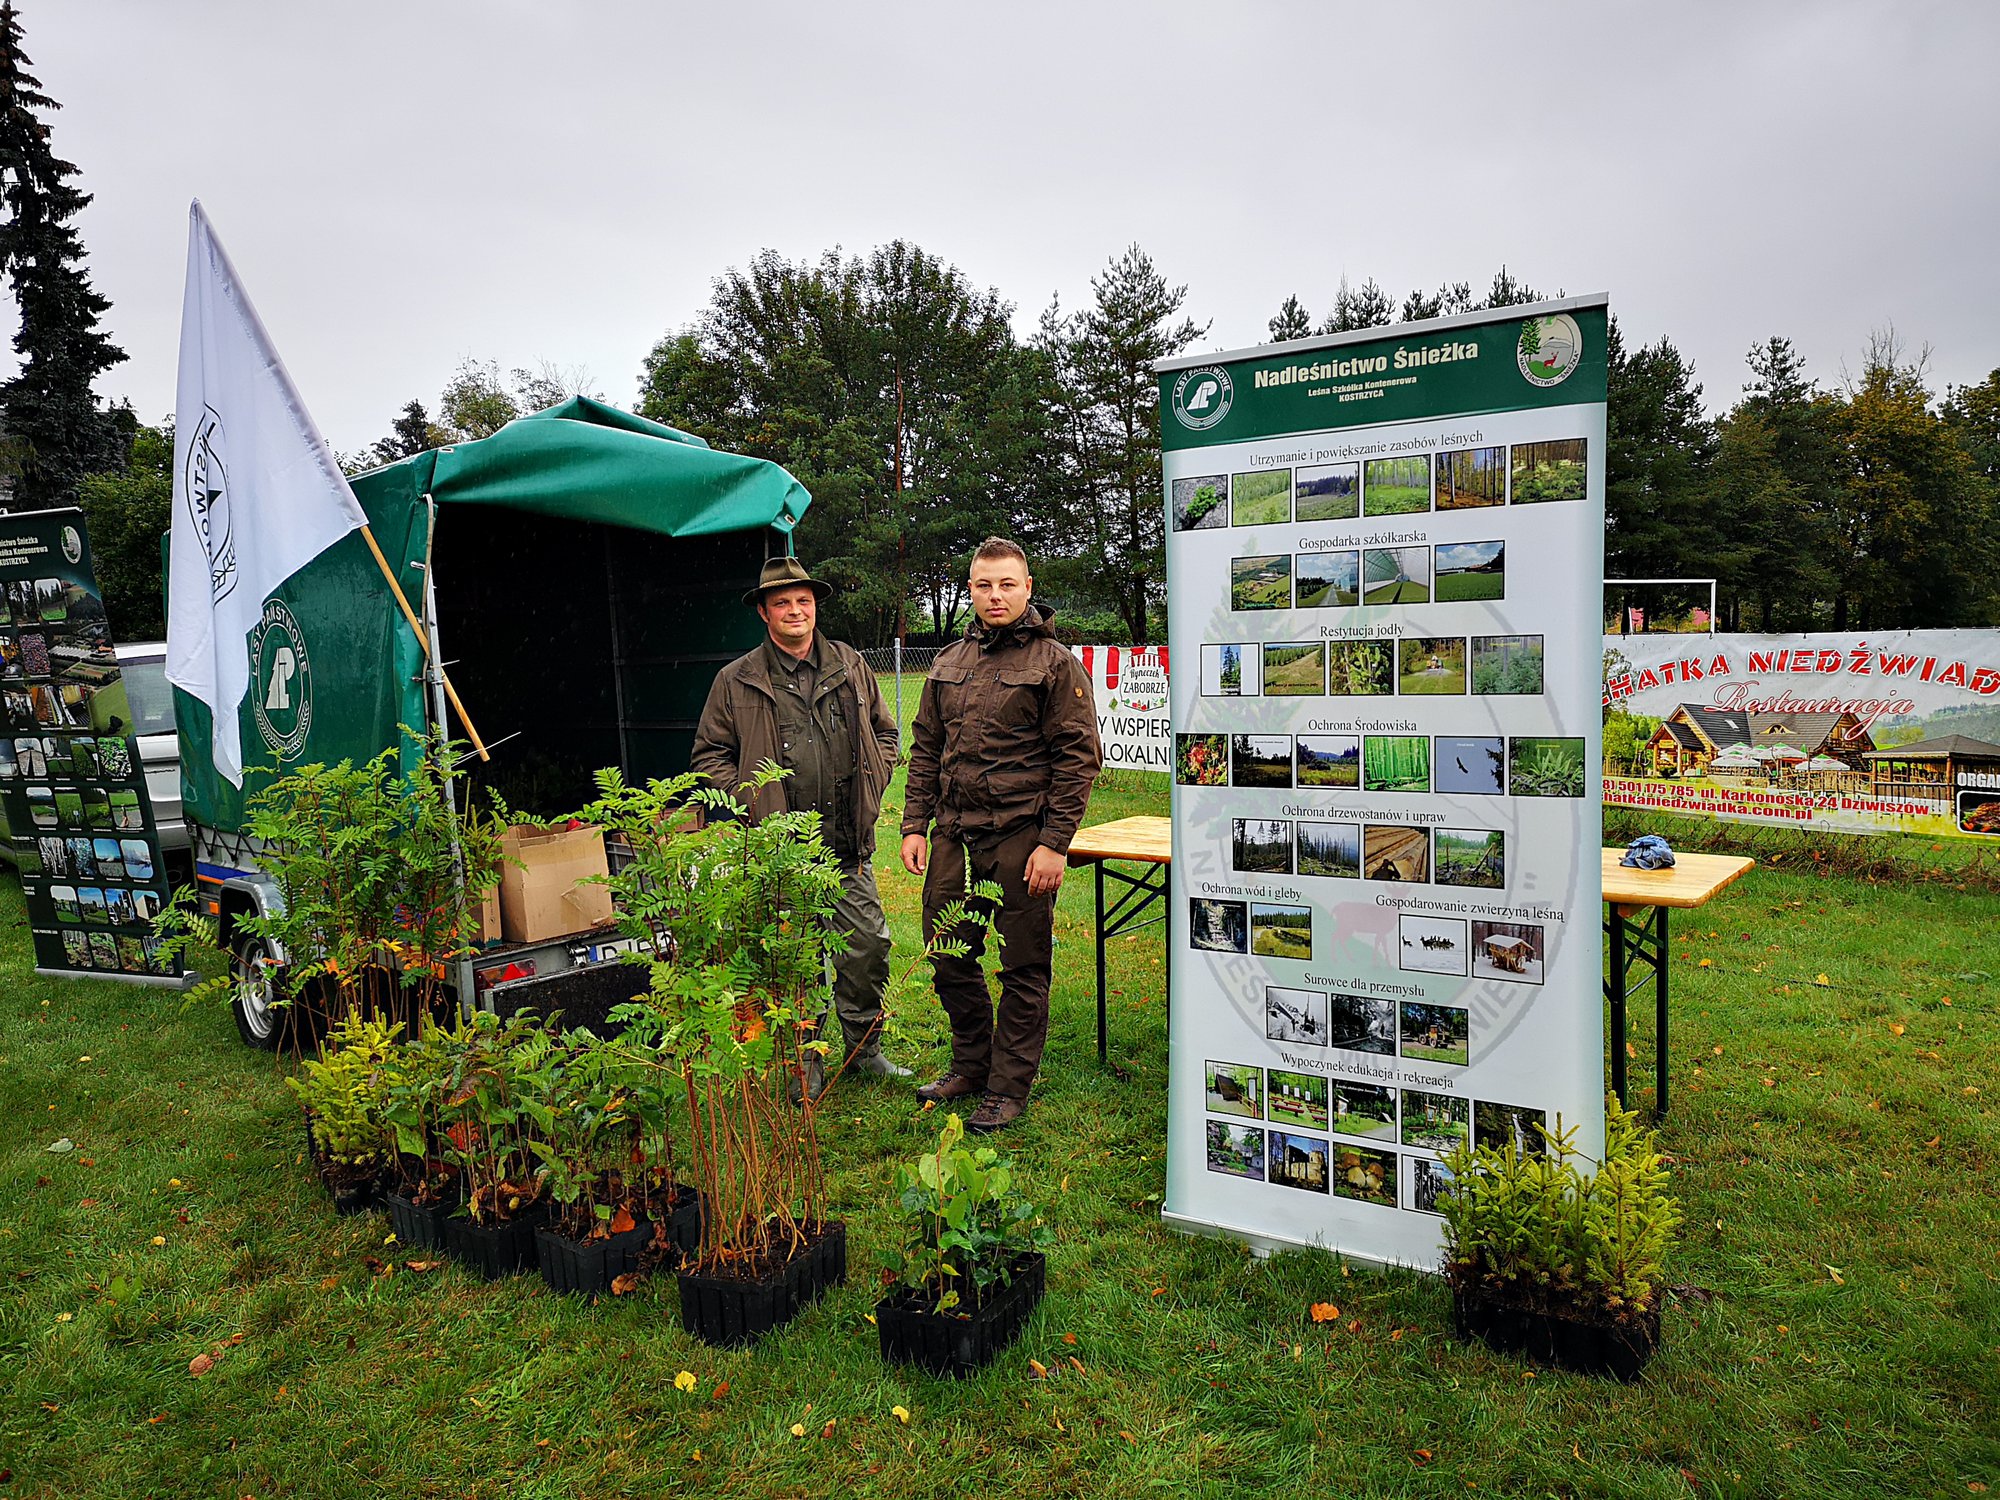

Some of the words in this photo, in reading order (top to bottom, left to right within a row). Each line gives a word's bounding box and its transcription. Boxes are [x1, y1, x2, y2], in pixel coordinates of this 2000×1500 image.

[1254, 356, 1387, 388] Nadleśnictwo
[1393, 342, 1478, 370] Śnieżka
[1175, 374, 1188, 398] LASY
[1308, 387, 1331, 397] Leśna
[1332, 383, 1363, 395] Szkółka
[1364, 375, 1417, 390] Kontenerowa
[1338, 389, 1384, 403] KOSTRZYCA
[1249, 450, 1307, 467] Utrzymanie
[1309, 448, 1313, 460] i
[1315, 441, 1387, 462] powiększanie
[1389, 436, 1438, 451] zasobów
[1440, 430, 1484, 447] leśnych
[1299, 532, 1361, 551] Gospodarka
[1363, 530, 1427, 545] szkółkarska
[251, 626, 263, 676] LASY
[261, 603, 308, 672] PAŃSTWOWE
[1320, 624, 1374, 639] Restytucja
[1377, 624, 1404, 638] jodły
[1123, 681, 1166, 694] ZABOBRZE
[1703, 680, 1916, 741] Restauracja
[1111, 716, 1171, 738] WSPIER
[1308, 719, 1351, 731] Ochrona
[1354, 716, 1417, 731] Środowiska
[1618, 781, 1641, 792] 501
[1645, 783, 1666, 794] 175
[1669, 785, 1695, 796] 785
[1700, 788, 1717, 800] ul.
[1721, 789, 1815, 807] Karkonoska
[1818, 796, 1838, 809] 24
[1841, 797, 1930, 815] Dziwiszów
[1281, 804, 1325, 818] Ochrona
[1327, 806, 1402, 821] drzewostanów
[1405, 809, 1409, 821] i
[1412, 812, 1446, 824] upraw
[1201, 881, 1242, 895] Ochrona
[1244, 885, 1266, 897] wód
[1268, 886, 1272, 897] i
[1274, 887, 1302, 901] gleby
[1375, 894, 1468, 913] Gospodarowanie
[1470, 902, 1530, 921] zwierzyną
[1532, 905, 1565, 923] leśną
[1303, 972, 1348, 989] Surowce
[1350, 977, 1367, 990] dla
[1369, 981, 1425, 997] przemysłu
[1280, 1052, 1345, 1072] Wypoczynek
[1347, 1063, 1394, 1082] edukacja
[1396, 1067, 1401, 1080] i
[1403, 1070, 1454, 1090] rekreacja
